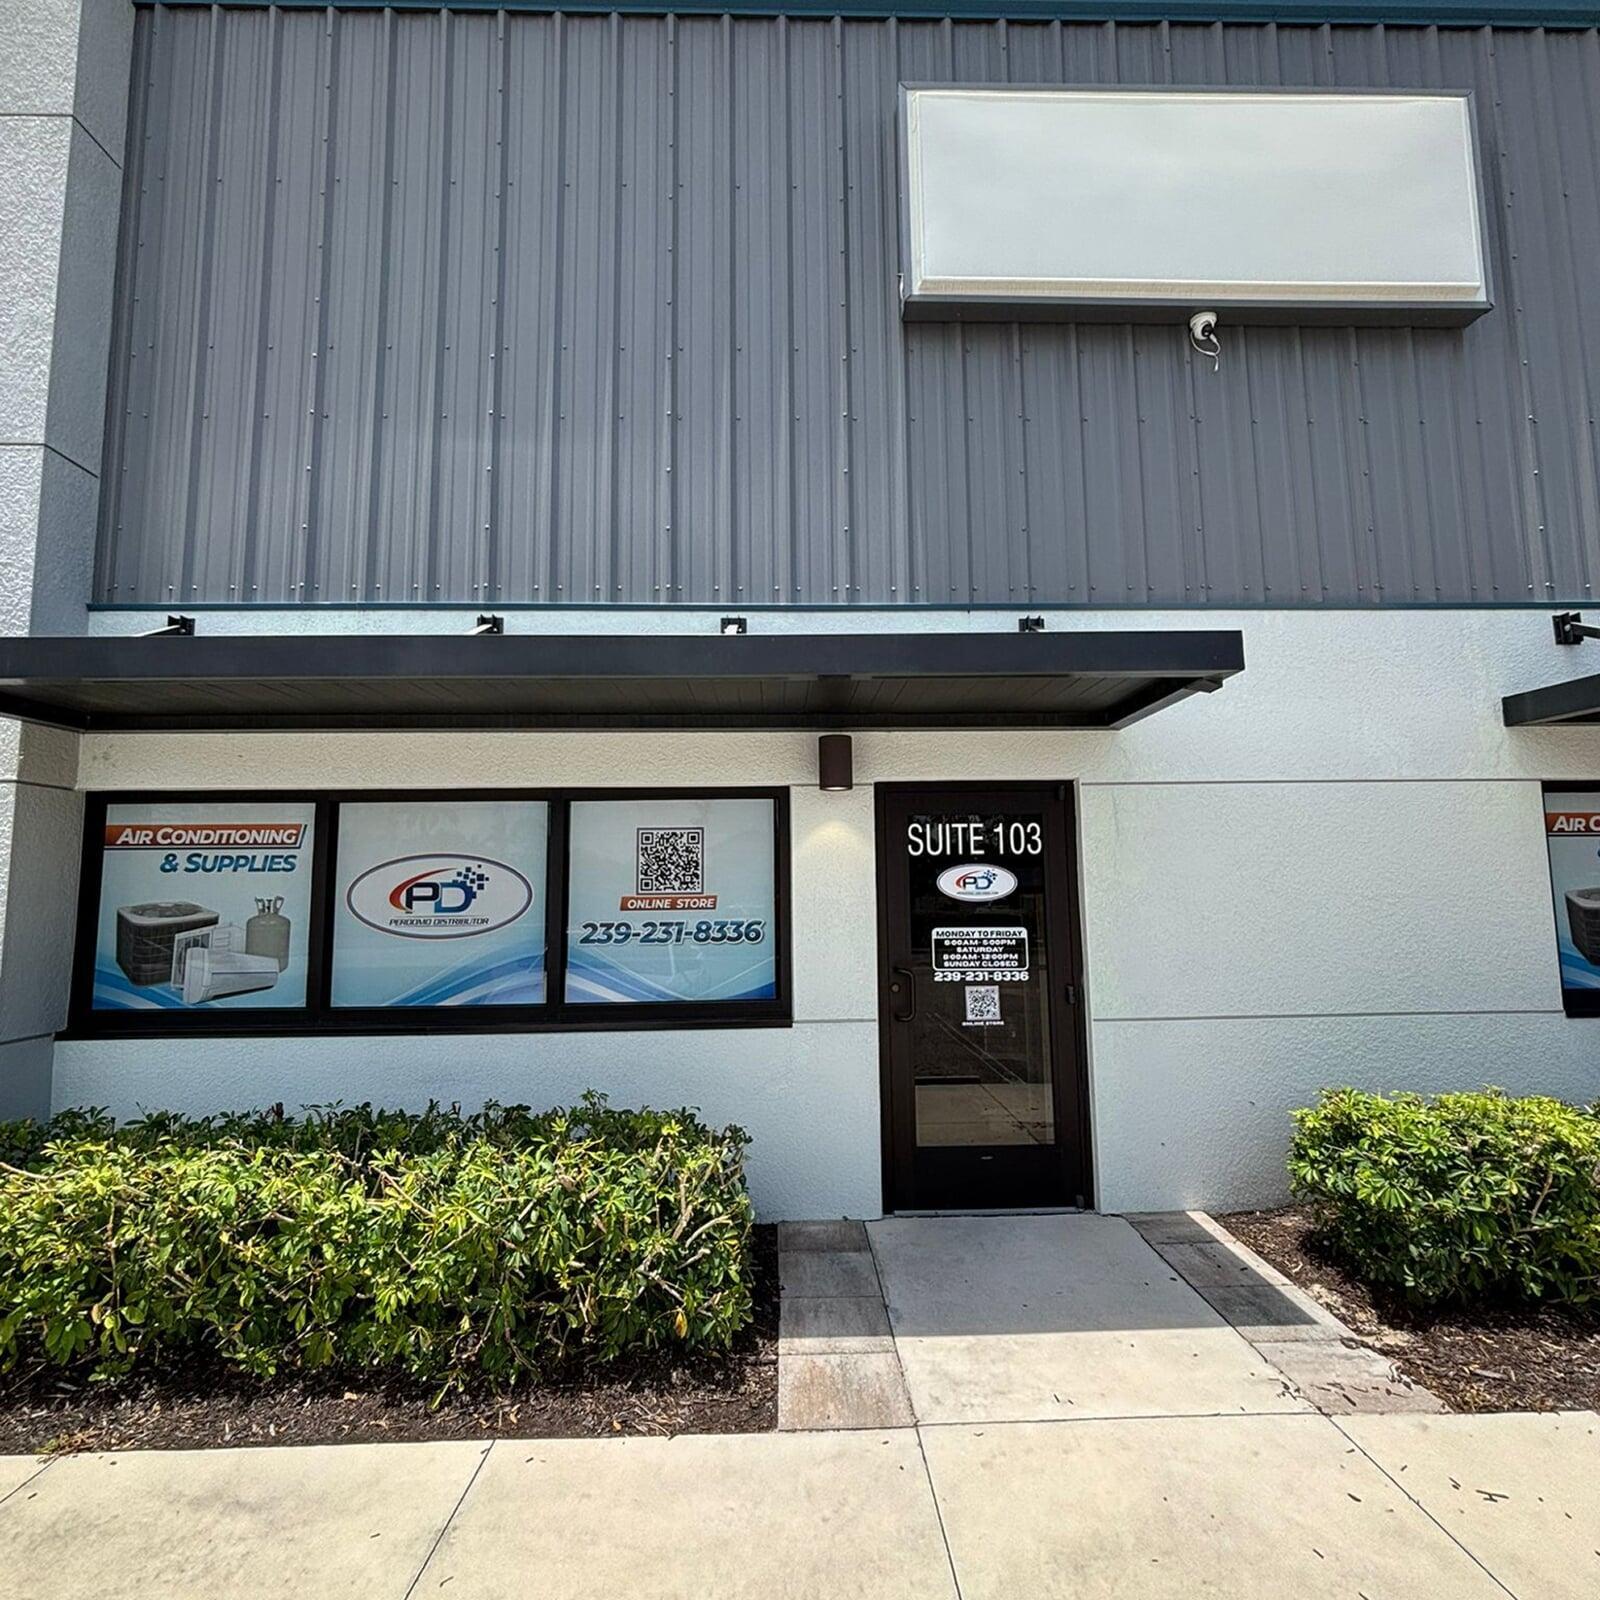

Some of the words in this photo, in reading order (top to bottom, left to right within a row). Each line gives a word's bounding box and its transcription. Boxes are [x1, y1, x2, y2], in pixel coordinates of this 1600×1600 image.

[1552, 815, 1586, 831] AIR
[116, 828, 153, 844] AIR
[156, 827, 297, 844] CONDITIONING
[907, 823, 985, 856] SUITE
[993, 822, 1042, 855] 103
[160, 853, 179, 873] &
[184, 853, 297, 873] SUPPLIES
[627, 899, 671, 909] ONLINE
[676, 898, 715, 908] STORE
[579, 919, 765, 945] 239-231-8336
[934, 971, 1029, 982] 239-231-8336
